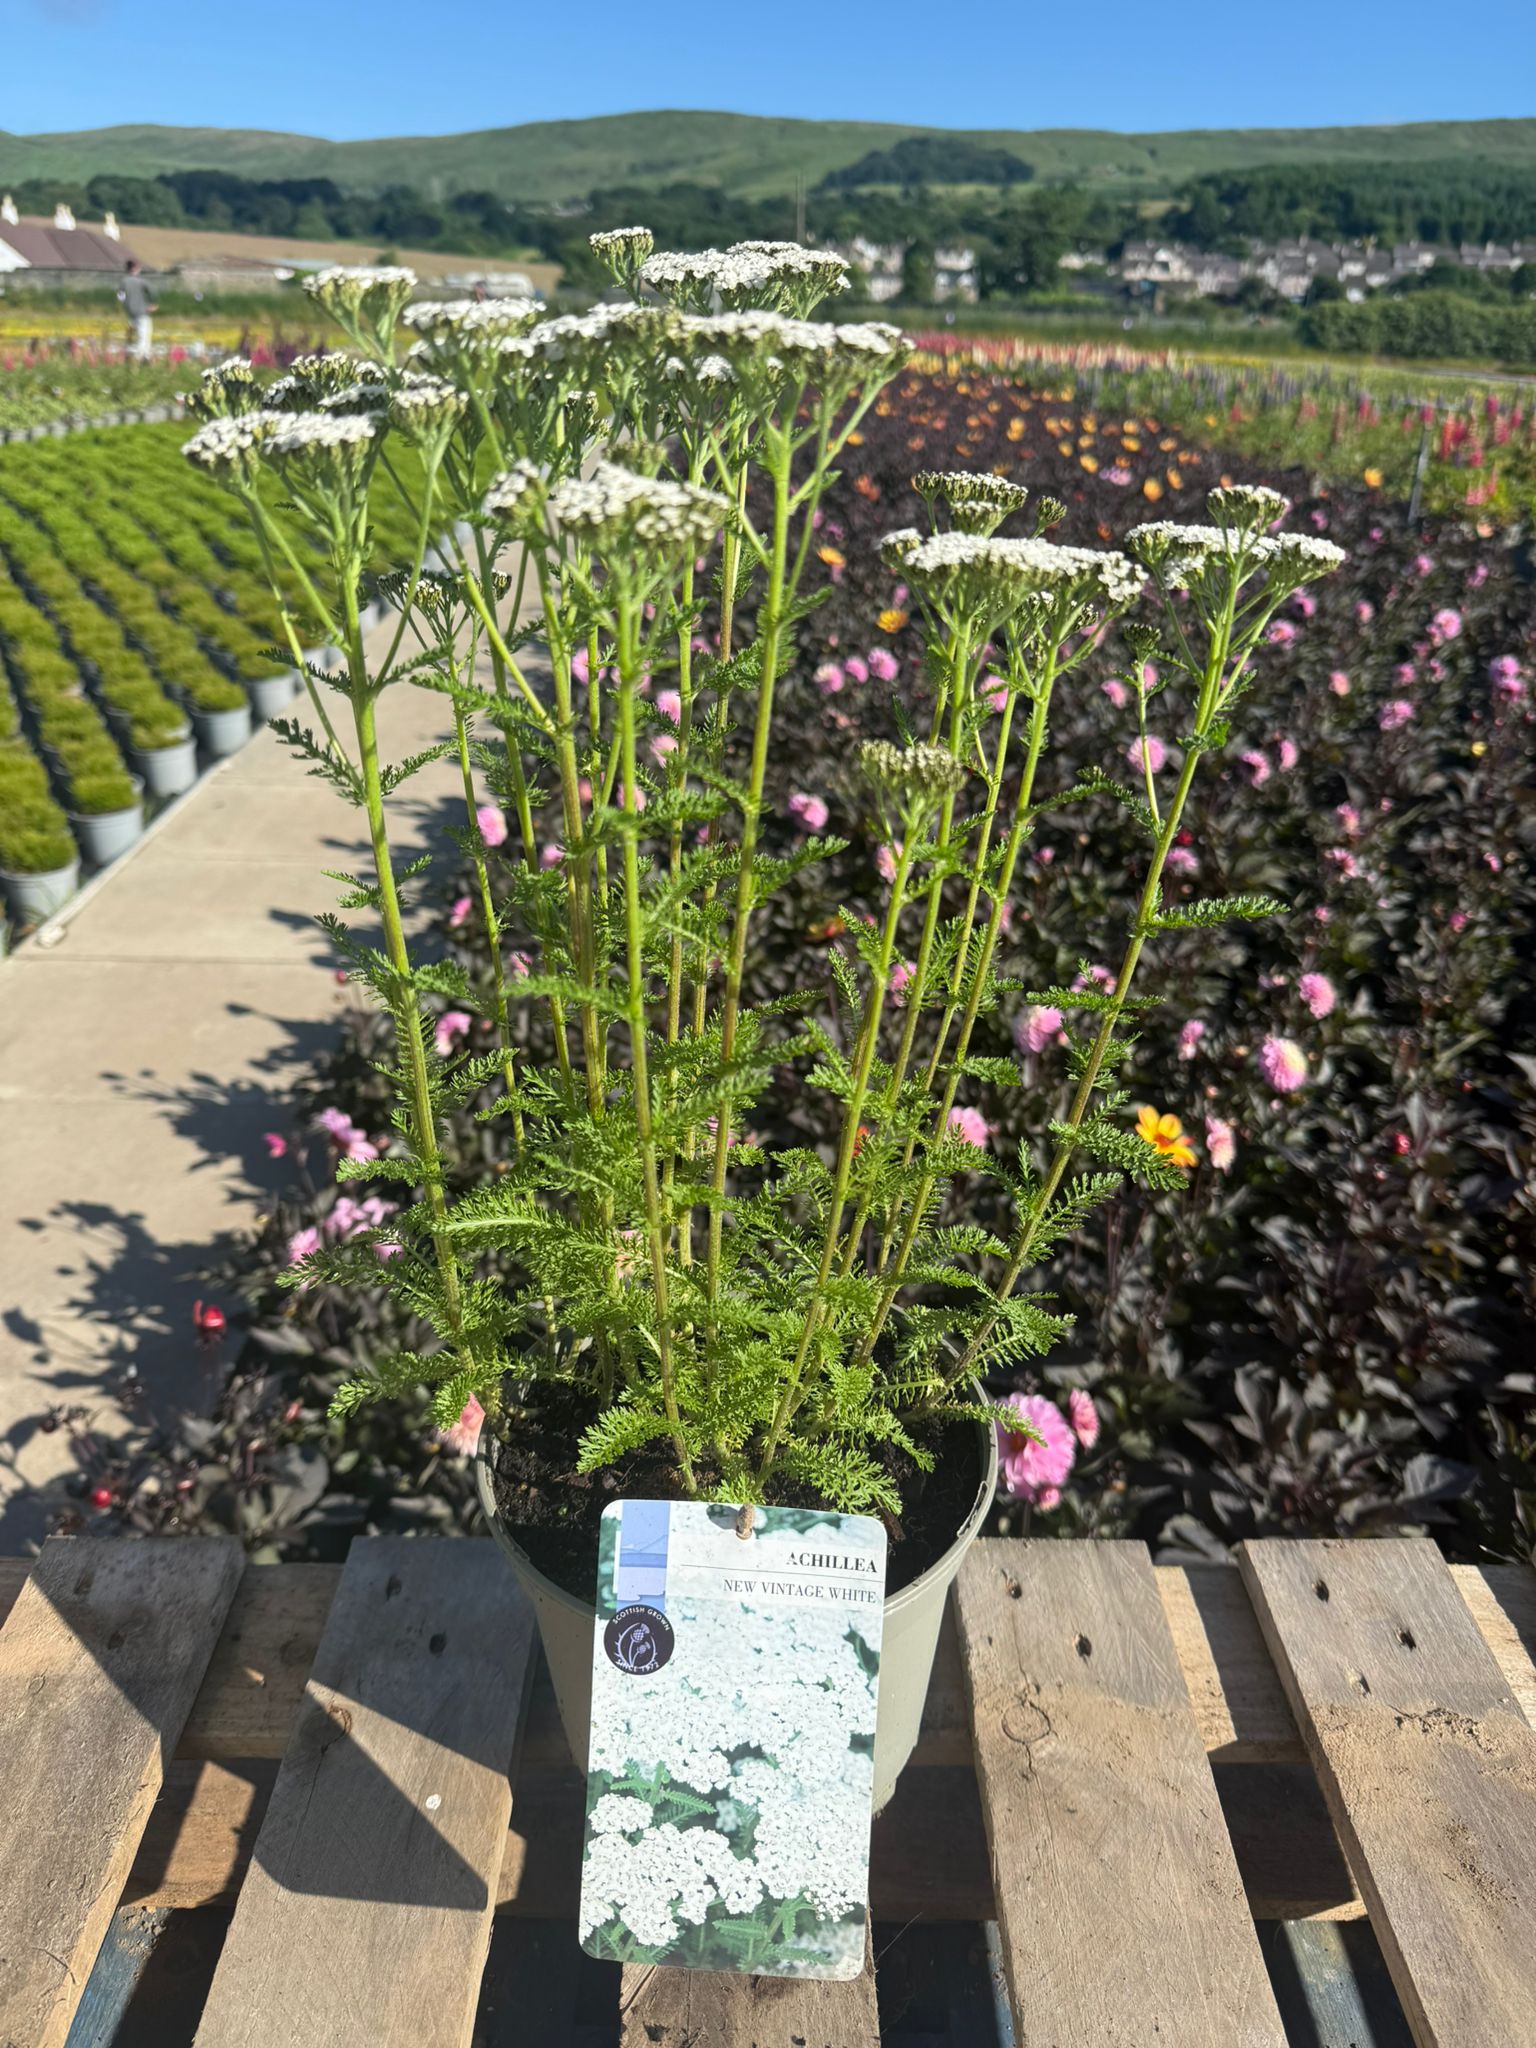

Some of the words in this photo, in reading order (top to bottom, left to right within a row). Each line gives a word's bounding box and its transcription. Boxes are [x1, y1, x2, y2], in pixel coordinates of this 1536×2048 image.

[786, 1552, 878, 1573] ACHILLEA
[724, 1579, 757, 1593] NEW
[762, 1582, 824, 1599] VINTAGE
[829, 1587, 877, 1603] WHITE
[612, 1606, 645, 1625] SCOTTISH
[647, 1608, 671, 1631] GROWN
